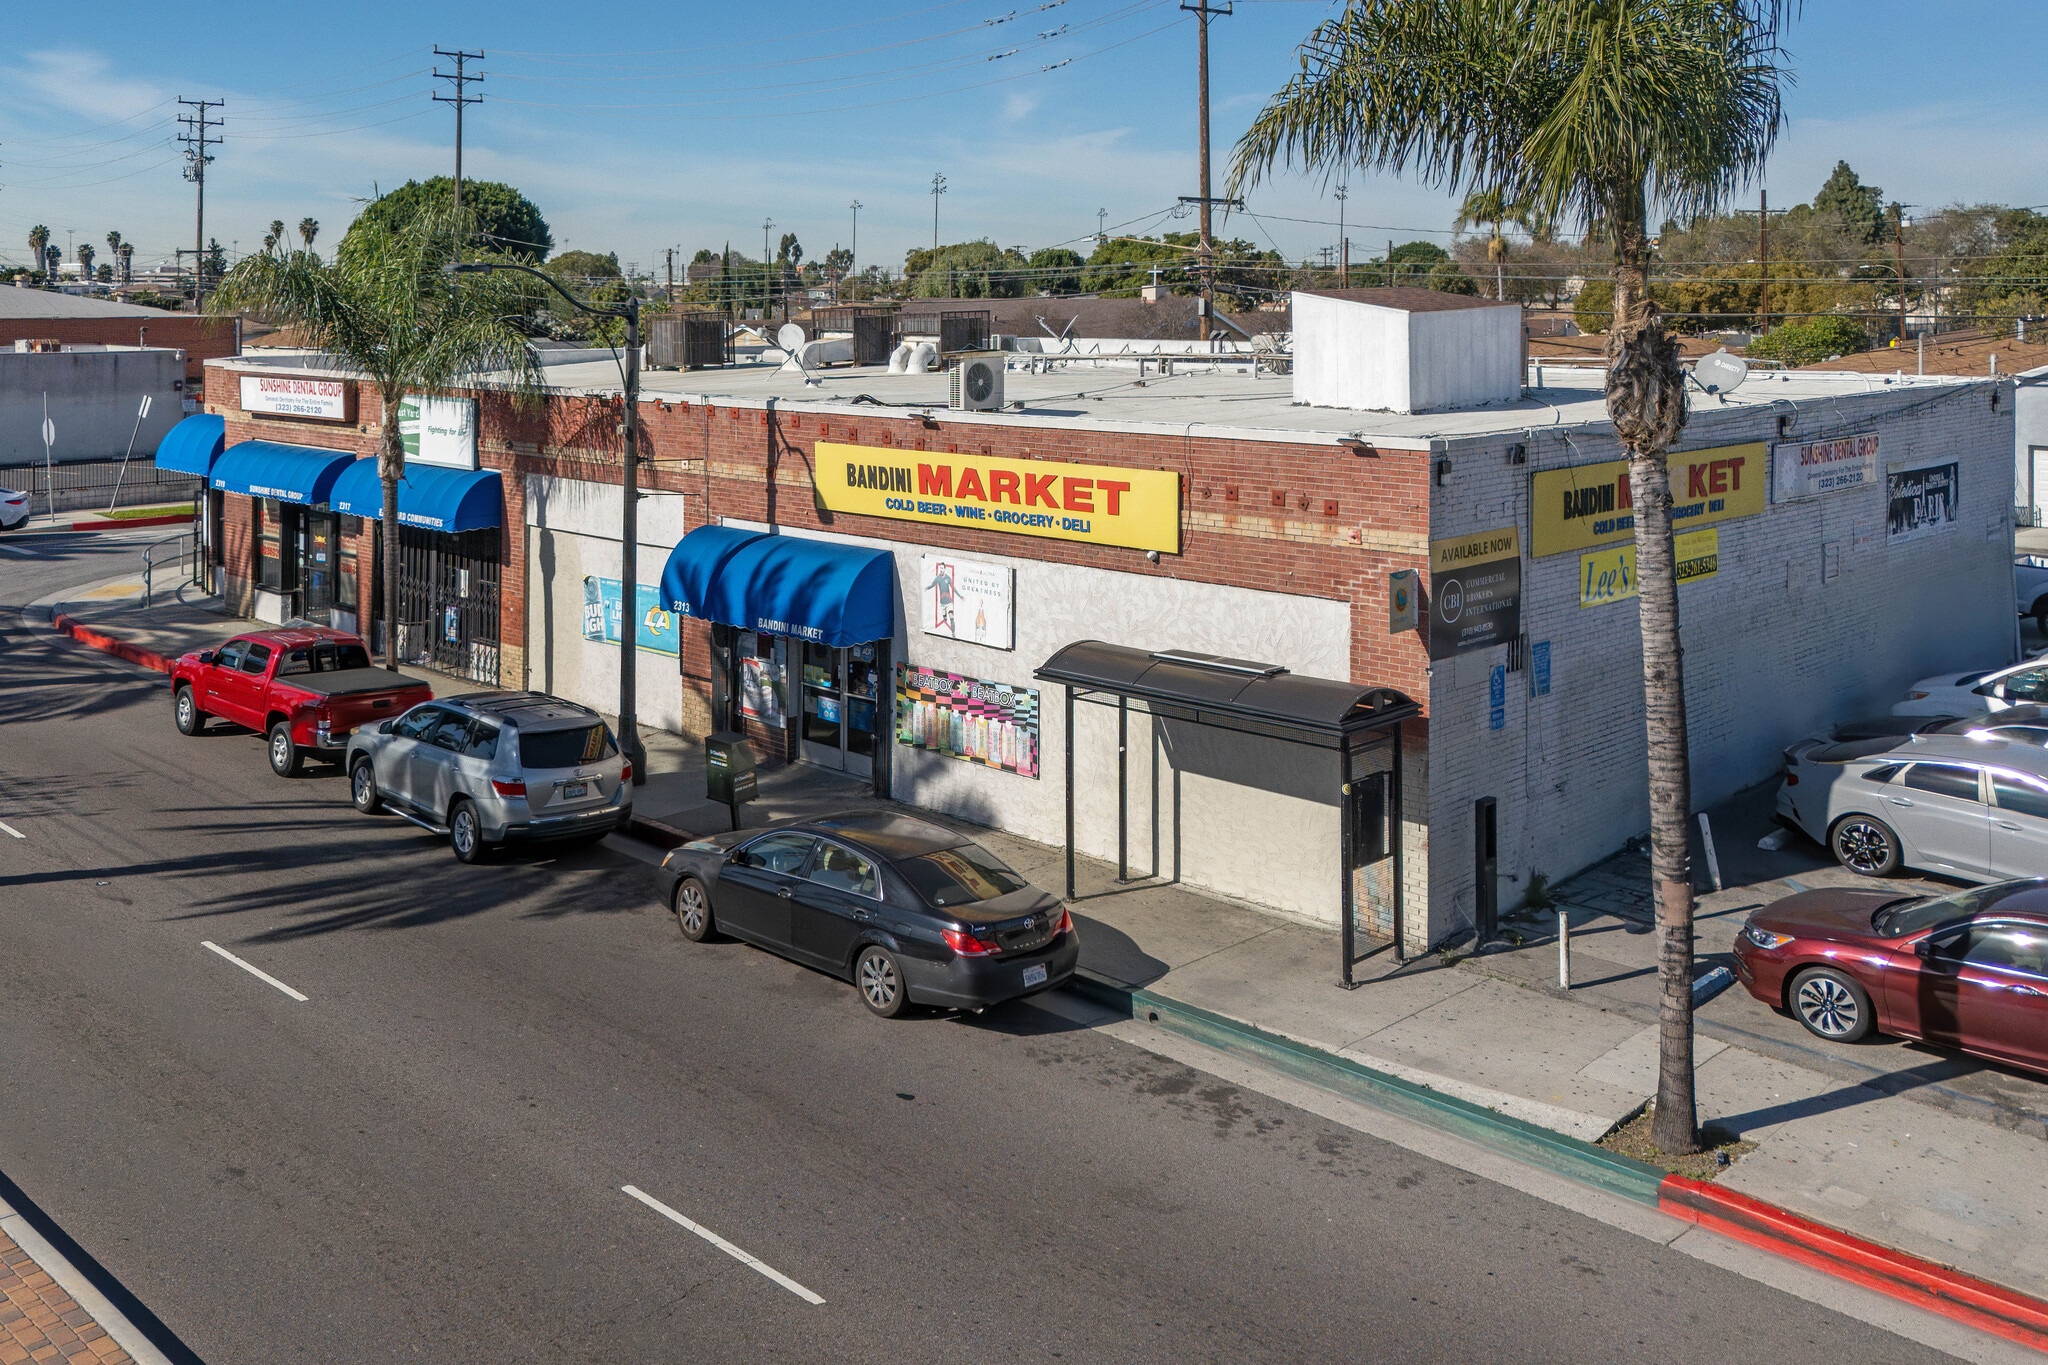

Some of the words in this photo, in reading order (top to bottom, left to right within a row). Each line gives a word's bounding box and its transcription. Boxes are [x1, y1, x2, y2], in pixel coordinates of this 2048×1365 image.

[260, 379, 292, 393] SUNSHINE
[293, 381, 317, 395] DENTAL
[318, 383, 342, 397] GROUP
[275, 404, 291, 412] (323)
[293, 405, 322, 414] 266-2120
[428, 426, 447, 436] Fighting
[1801, 444, 1832, 466] SUNSHINE
[1834, 439, 1856, 460] DENTAL
[1858, 436, 1879, 457] GROUP
[846, 463, 912, 493] BANDINI
[917, 463, 1130, 516] MARKET
[1818, 477, 1834, 490] (323)
[1836, 472, 1863, 485] 266-2120
[250, 485, 270, 495] SUNSHINE
[271, 488, 287, 498] DENTAL
[288, 491, 303, 500] GROUP
[1563, 483, 1614, 520] BANDINI
[339, 502, 351, 511] 2317
[885, 498, 915, 512] COLD
[917, 501, 946, 515] BEER
[955, 505, 985, 520] WINE
[993, 509, 1054, 528] GROCERY
[1062, 517, 1091, 533] DELI
[1913, 492, 1945, 524] PARIS
[407, 513, 443, 527] COMMUNITIES
[1593, 518, 1615, 535] COLD
[1708, 498, 1725, 513] DELI
[1441, 542, 1488, 563] AVAILABLE
[1490, 537, 1512, 553] NOW
[963, 577, 989, 586] UNITED
[1465, 572, 1505, 588] COMMERCIAL
[1584, 554, 1629, 603] Lee's
[962, 585, 1001, 597] GREATNESS
[1465, 590, 1493, 602] BROKERS
[673, 601, 690, 612] 2313
[1444, 593, 1460, 610] CBI
[1465, 598, 1512, 617] INTERNATIONAL
[758, 618, 788, 633] BANDINI
[791, 624, 823, 640] MARKET
[912, 673, 954, 694] BEATBOX
[971, 686, 1016, 708] BEATBOX
